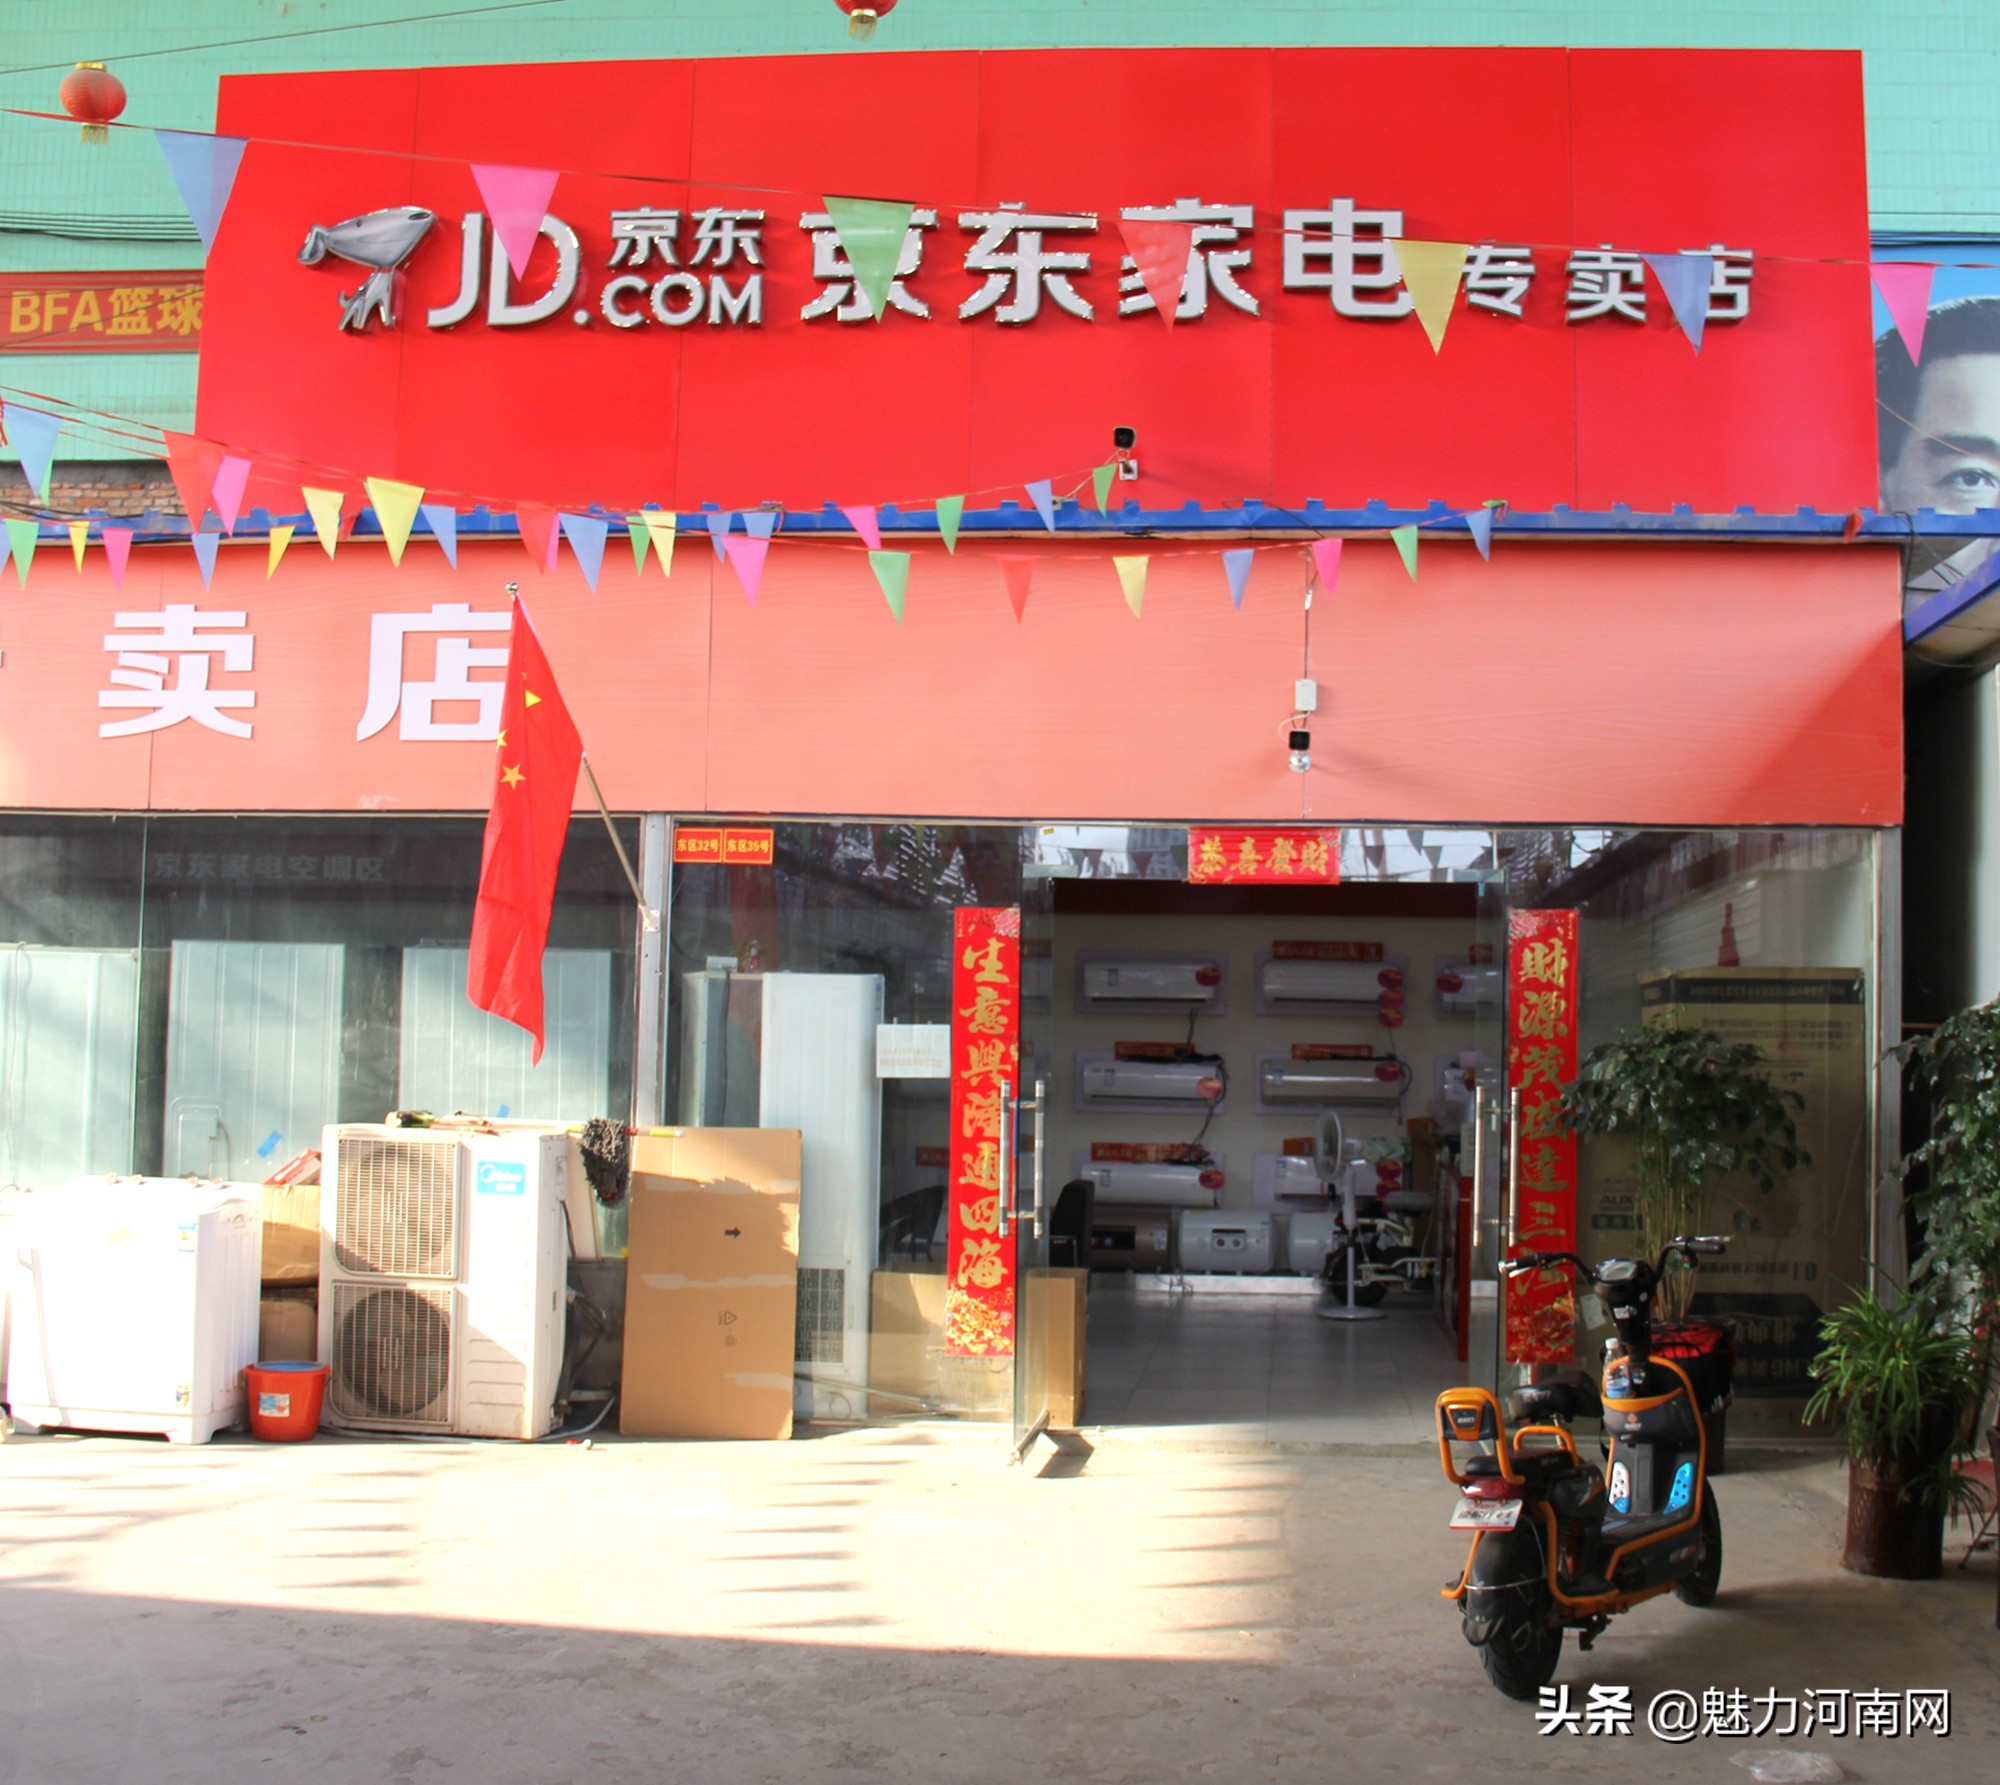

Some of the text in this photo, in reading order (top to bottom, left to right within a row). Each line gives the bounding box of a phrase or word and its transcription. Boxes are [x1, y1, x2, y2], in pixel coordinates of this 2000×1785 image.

[606, 206, 767, 267] 京东
[0, 603, 513, 742] 卖店
[676, 838, 720, 854] 东区32号
[726, 839, 771, 854] 东区35号
[153, 851, 386, 882] 京东家电空调区
